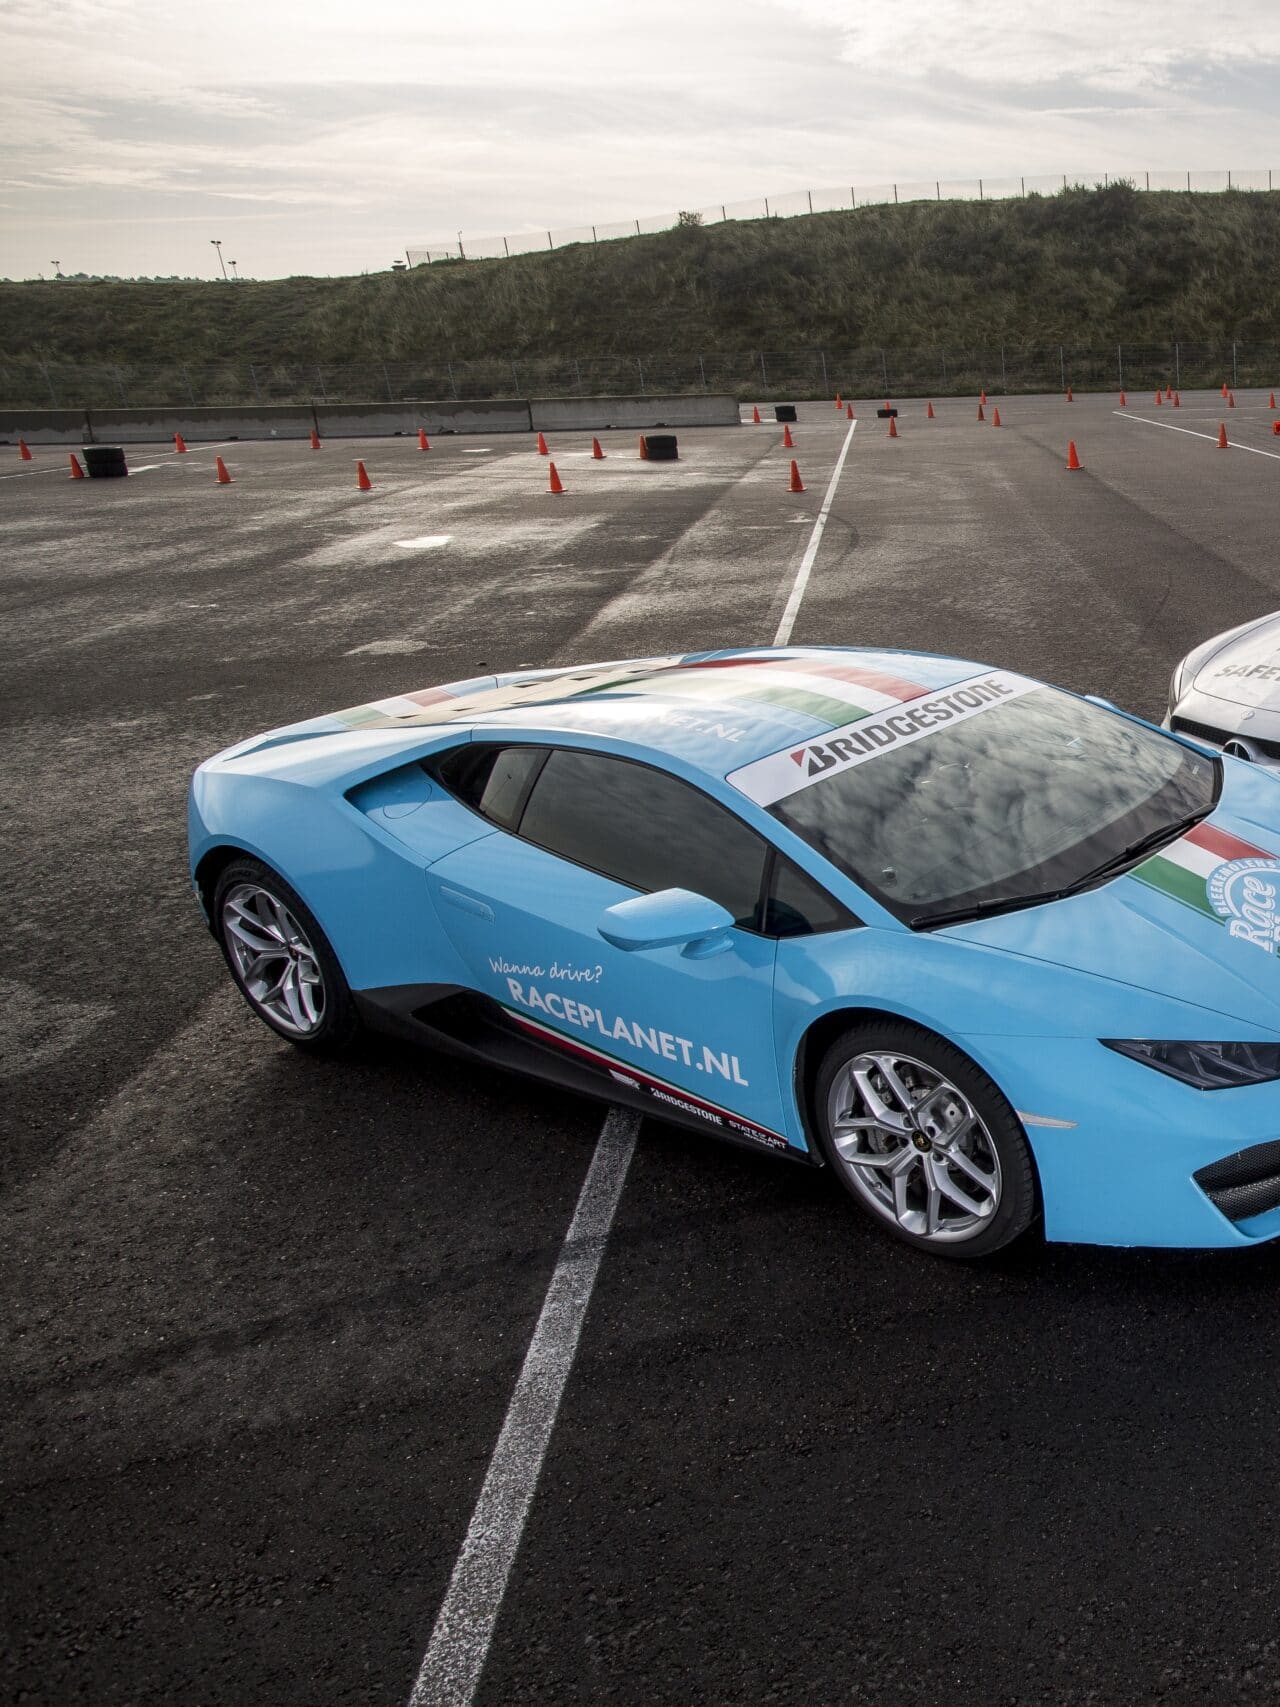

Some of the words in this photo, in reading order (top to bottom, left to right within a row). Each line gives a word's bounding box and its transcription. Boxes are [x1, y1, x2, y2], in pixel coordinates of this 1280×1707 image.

[790, 678, 1014, 778] BRIDGESTONE
[1210, 859, 1277, 914] BLEEKEMOLENS
[1229, 875, 1276, 954] Race
[488, 956, 545, 977] Wanna
[549, 961, 603, 984] drive?
[506, 977, 749, 1087] RACEPLANET.NL
[650, 1087, 723, 1126] BRIDGESTONE
